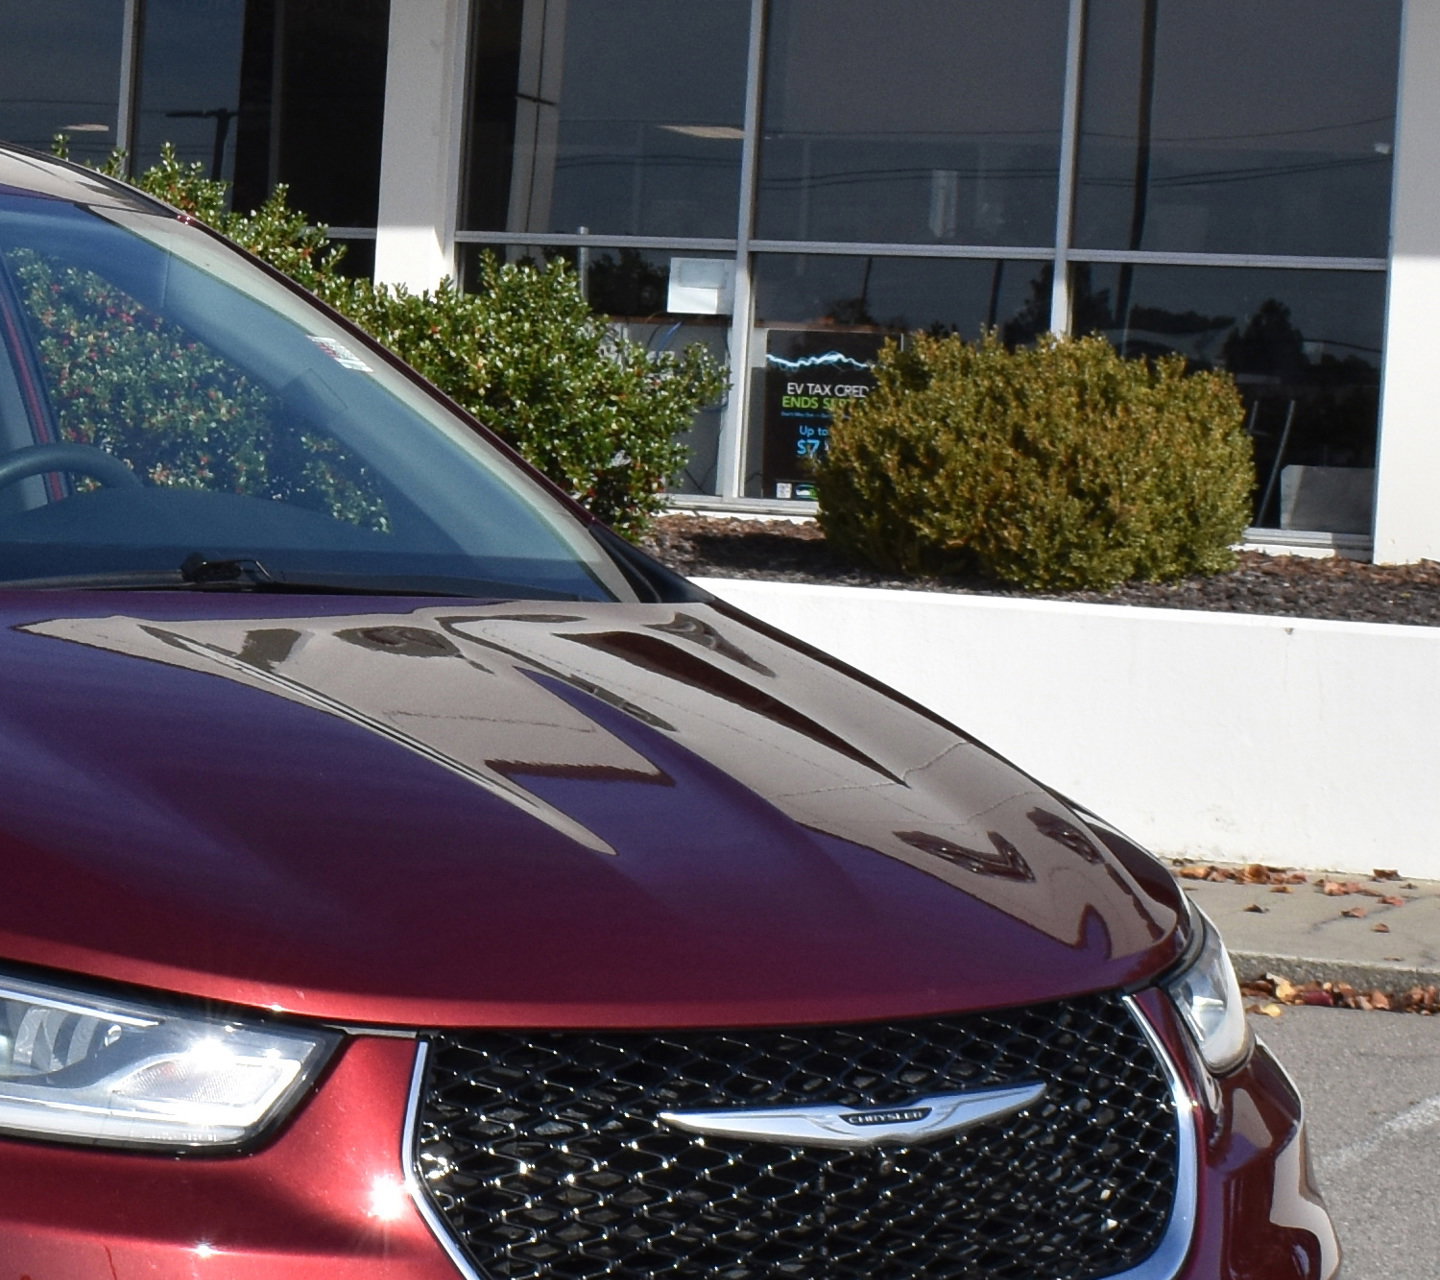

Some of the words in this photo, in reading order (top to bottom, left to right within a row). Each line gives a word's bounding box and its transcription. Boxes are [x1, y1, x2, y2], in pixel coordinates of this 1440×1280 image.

[787, 382, 804, 395] EV
[806, 383, 832, 396] TAX
[834, 384, 874, 398] CRED
[782, 395, 818, 409] ENDS
[799, 425, 815, 437] Up
[817, 427, 829, 436] to
[849, 1111, 923, 1124] CHRYSLER
